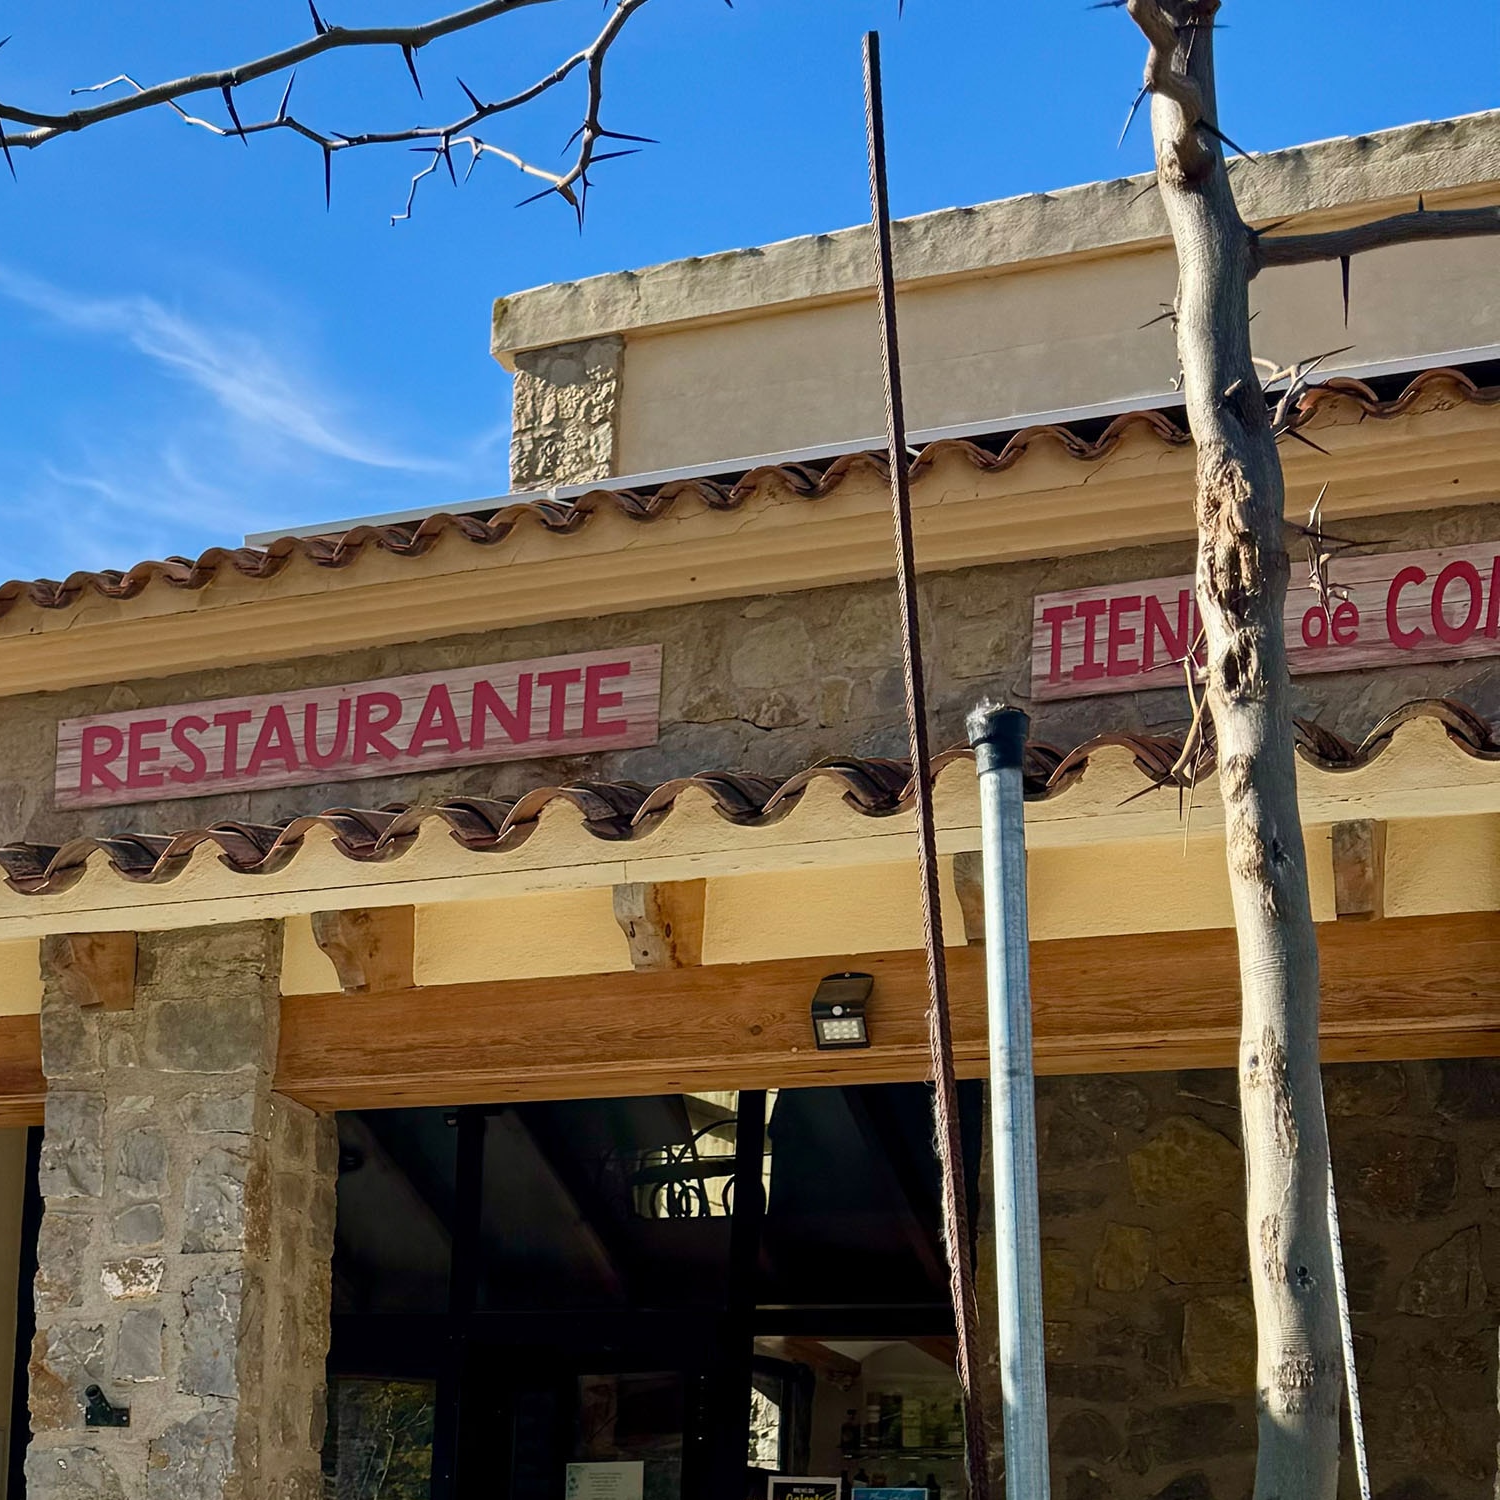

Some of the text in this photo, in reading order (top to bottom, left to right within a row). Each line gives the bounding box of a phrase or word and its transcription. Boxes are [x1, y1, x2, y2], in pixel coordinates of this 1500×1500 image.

[1302, 600, 1360, 649] de
[1387, 556, 1500, 651] CO
[80, 661, 631, 793] RESTAURANTE
